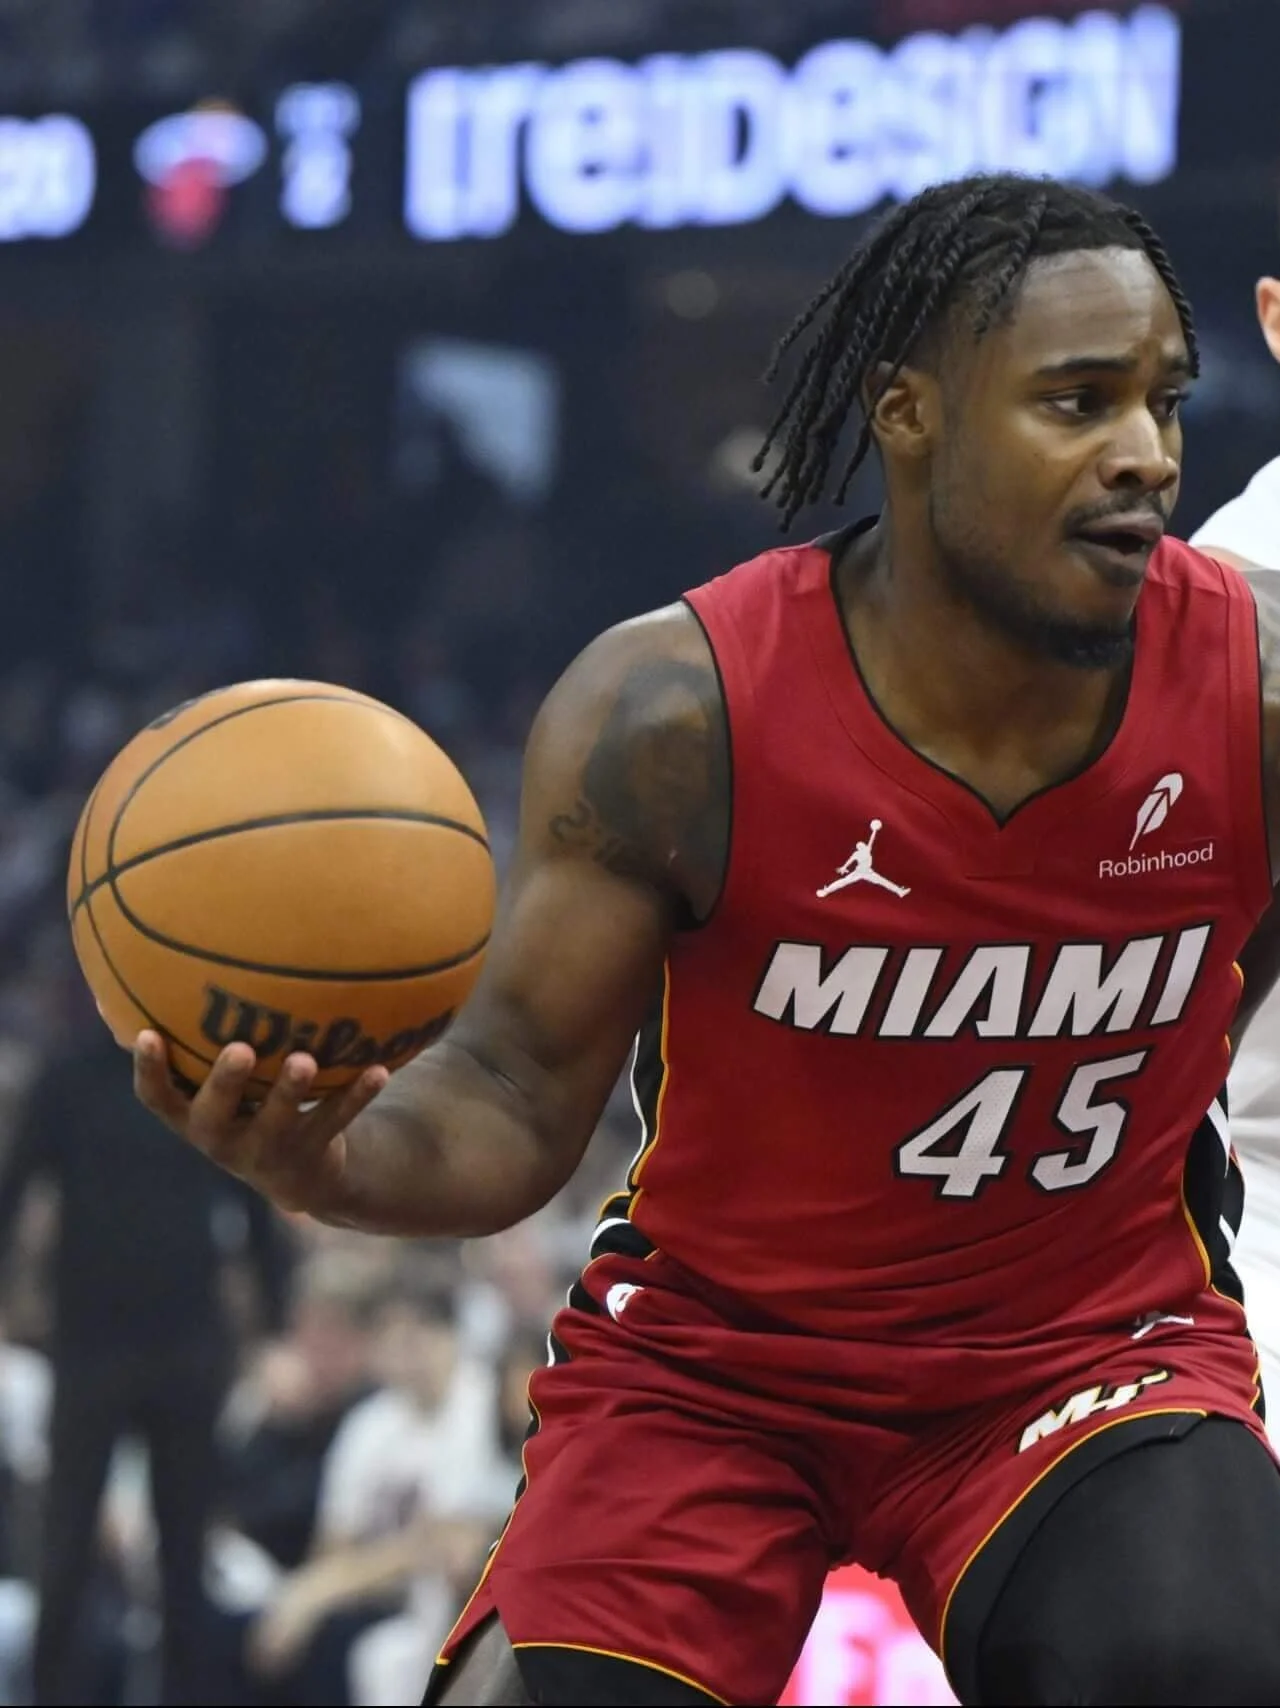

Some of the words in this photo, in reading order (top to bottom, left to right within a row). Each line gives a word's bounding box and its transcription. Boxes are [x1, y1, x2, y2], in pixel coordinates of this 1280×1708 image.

[1098, 844, 1214, 878] Robinhood
[752, 922, 1213, 1040] MIAMI
[894, 1045, 1155, 1200] 45
